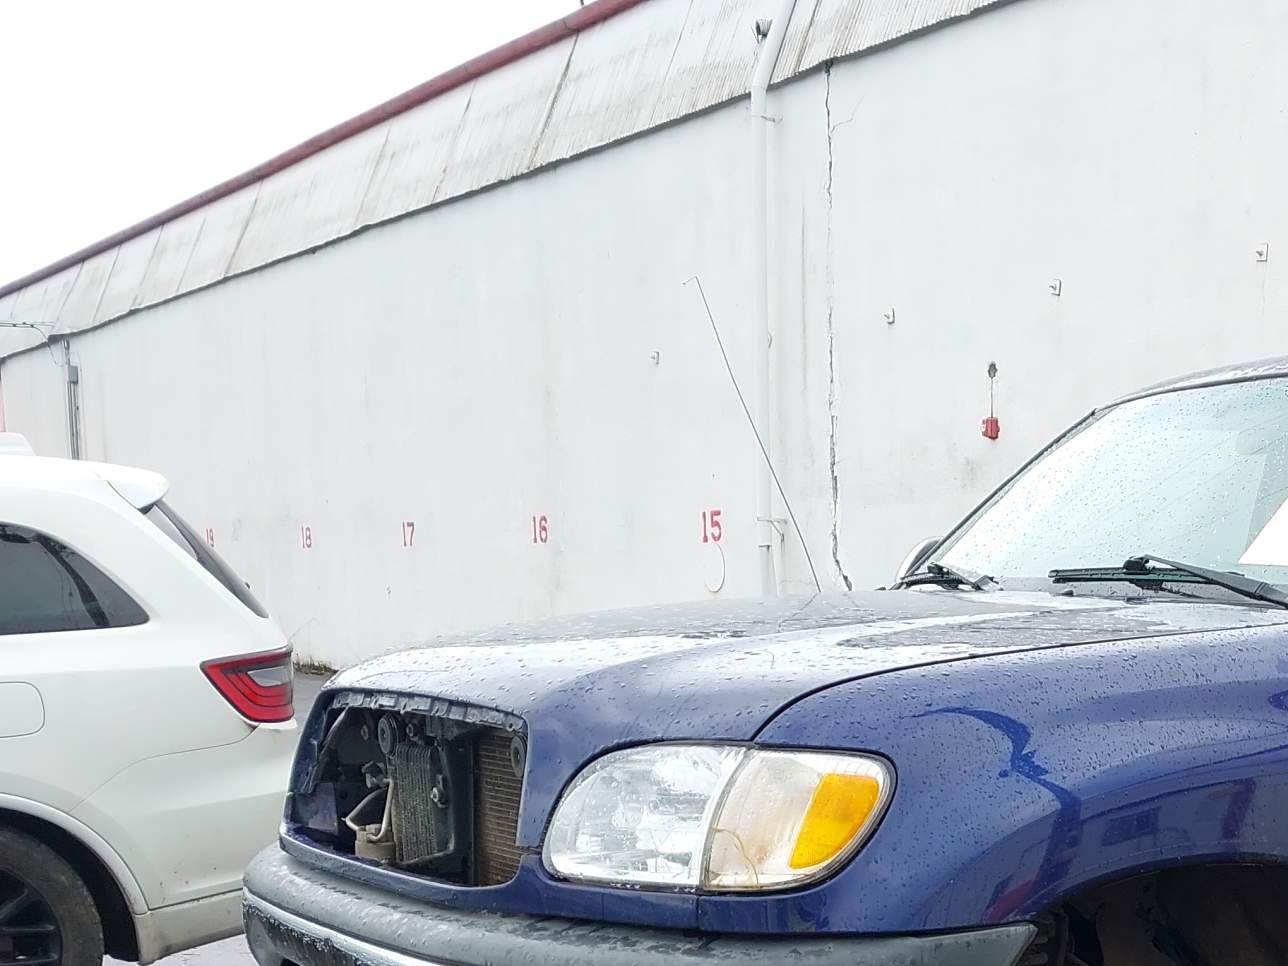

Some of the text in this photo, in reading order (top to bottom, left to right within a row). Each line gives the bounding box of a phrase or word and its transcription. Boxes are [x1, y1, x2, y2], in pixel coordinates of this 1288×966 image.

[301, 526, 312, 549] 18
[401, 522, 415, 547] 17
[532, 515, 548, 543] 16
[702, 510, 722, 543] 15
